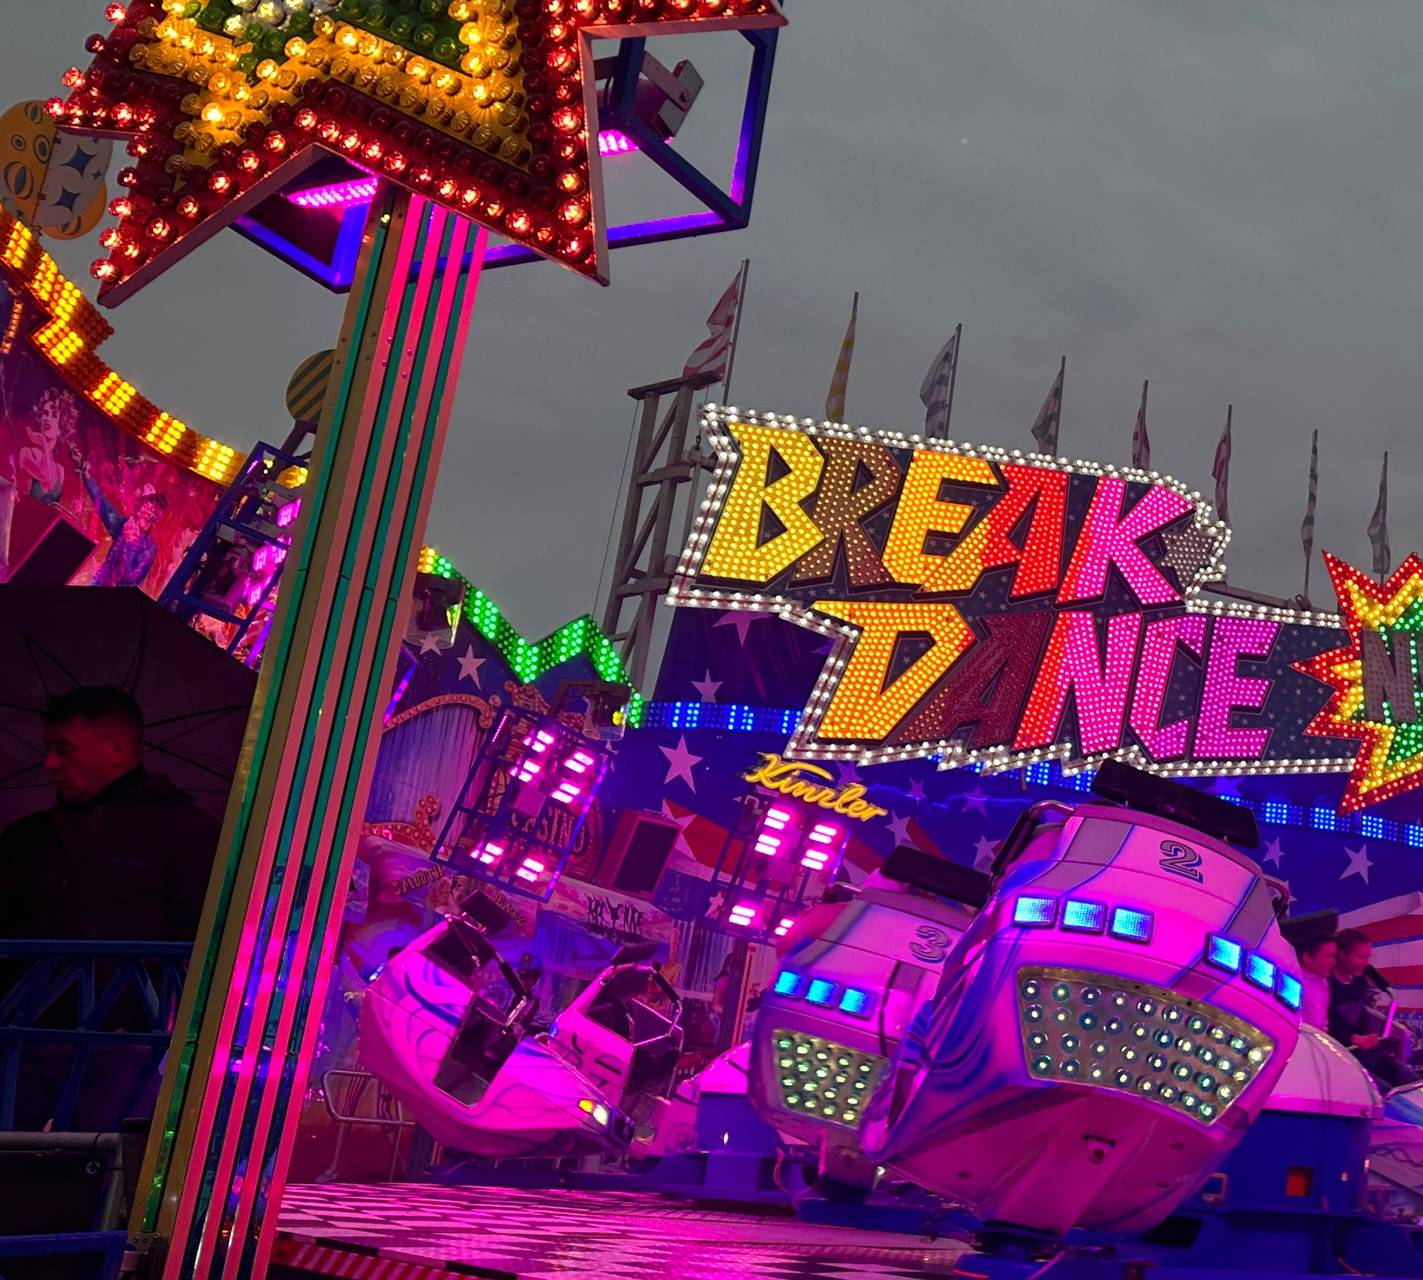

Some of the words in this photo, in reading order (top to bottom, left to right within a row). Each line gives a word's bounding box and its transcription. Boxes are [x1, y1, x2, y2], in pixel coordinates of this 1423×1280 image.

[699, 421, 1196, 606] BREAK
[808, 599, 1282, 760] DANCE
[744, 752, 888, 822] Kinzler
[1159, 839, 1204, 884] 2
[908, 925, 952, 964] 3
